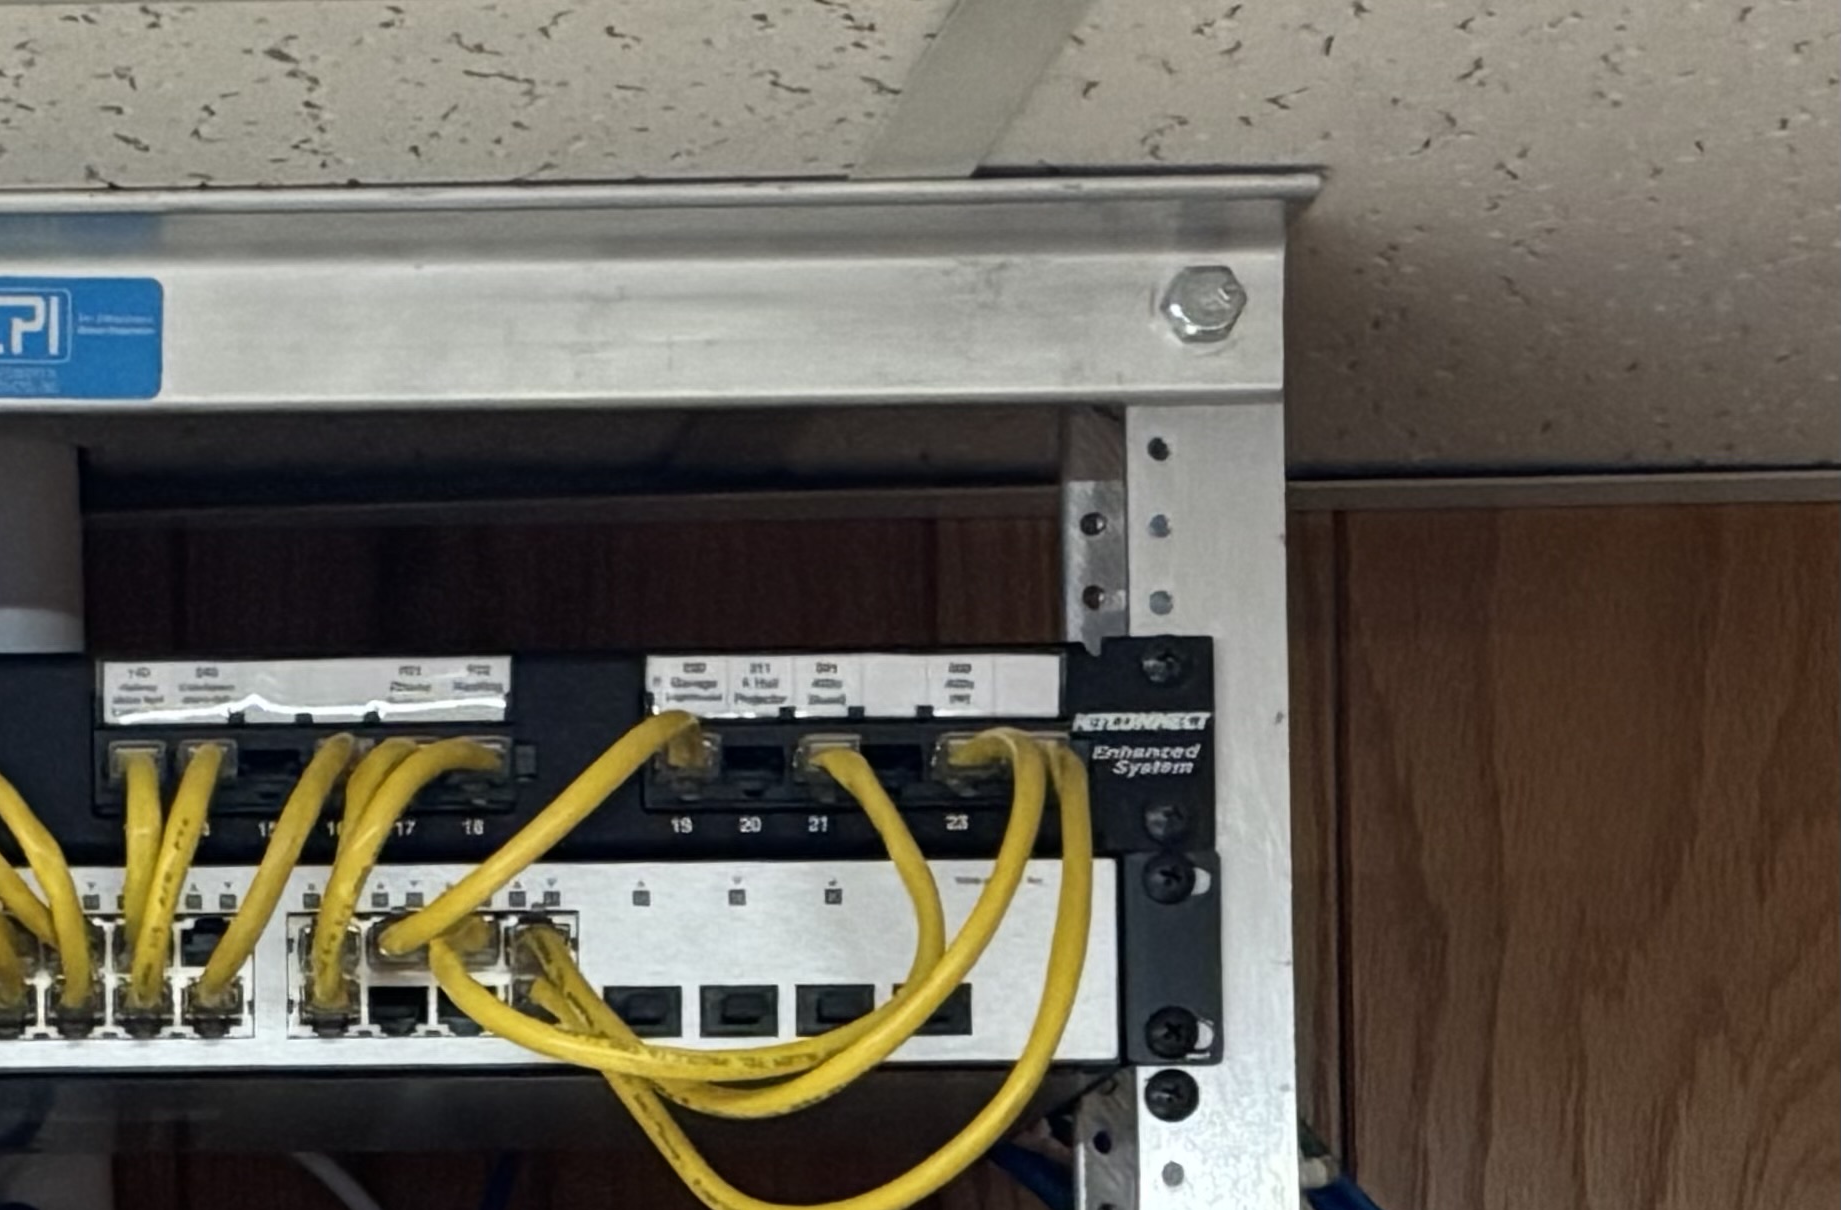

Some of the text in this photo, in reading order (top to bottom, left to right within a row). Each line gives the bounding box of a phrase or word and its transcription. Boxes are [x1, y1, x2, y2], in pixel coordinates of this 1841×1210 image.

[1092, 744, 1201, 760] Enhanced
[1112, 759, 1194, 778] System
[739, 818, 761, 833] 20
[808, 816, 828, 832] 21
